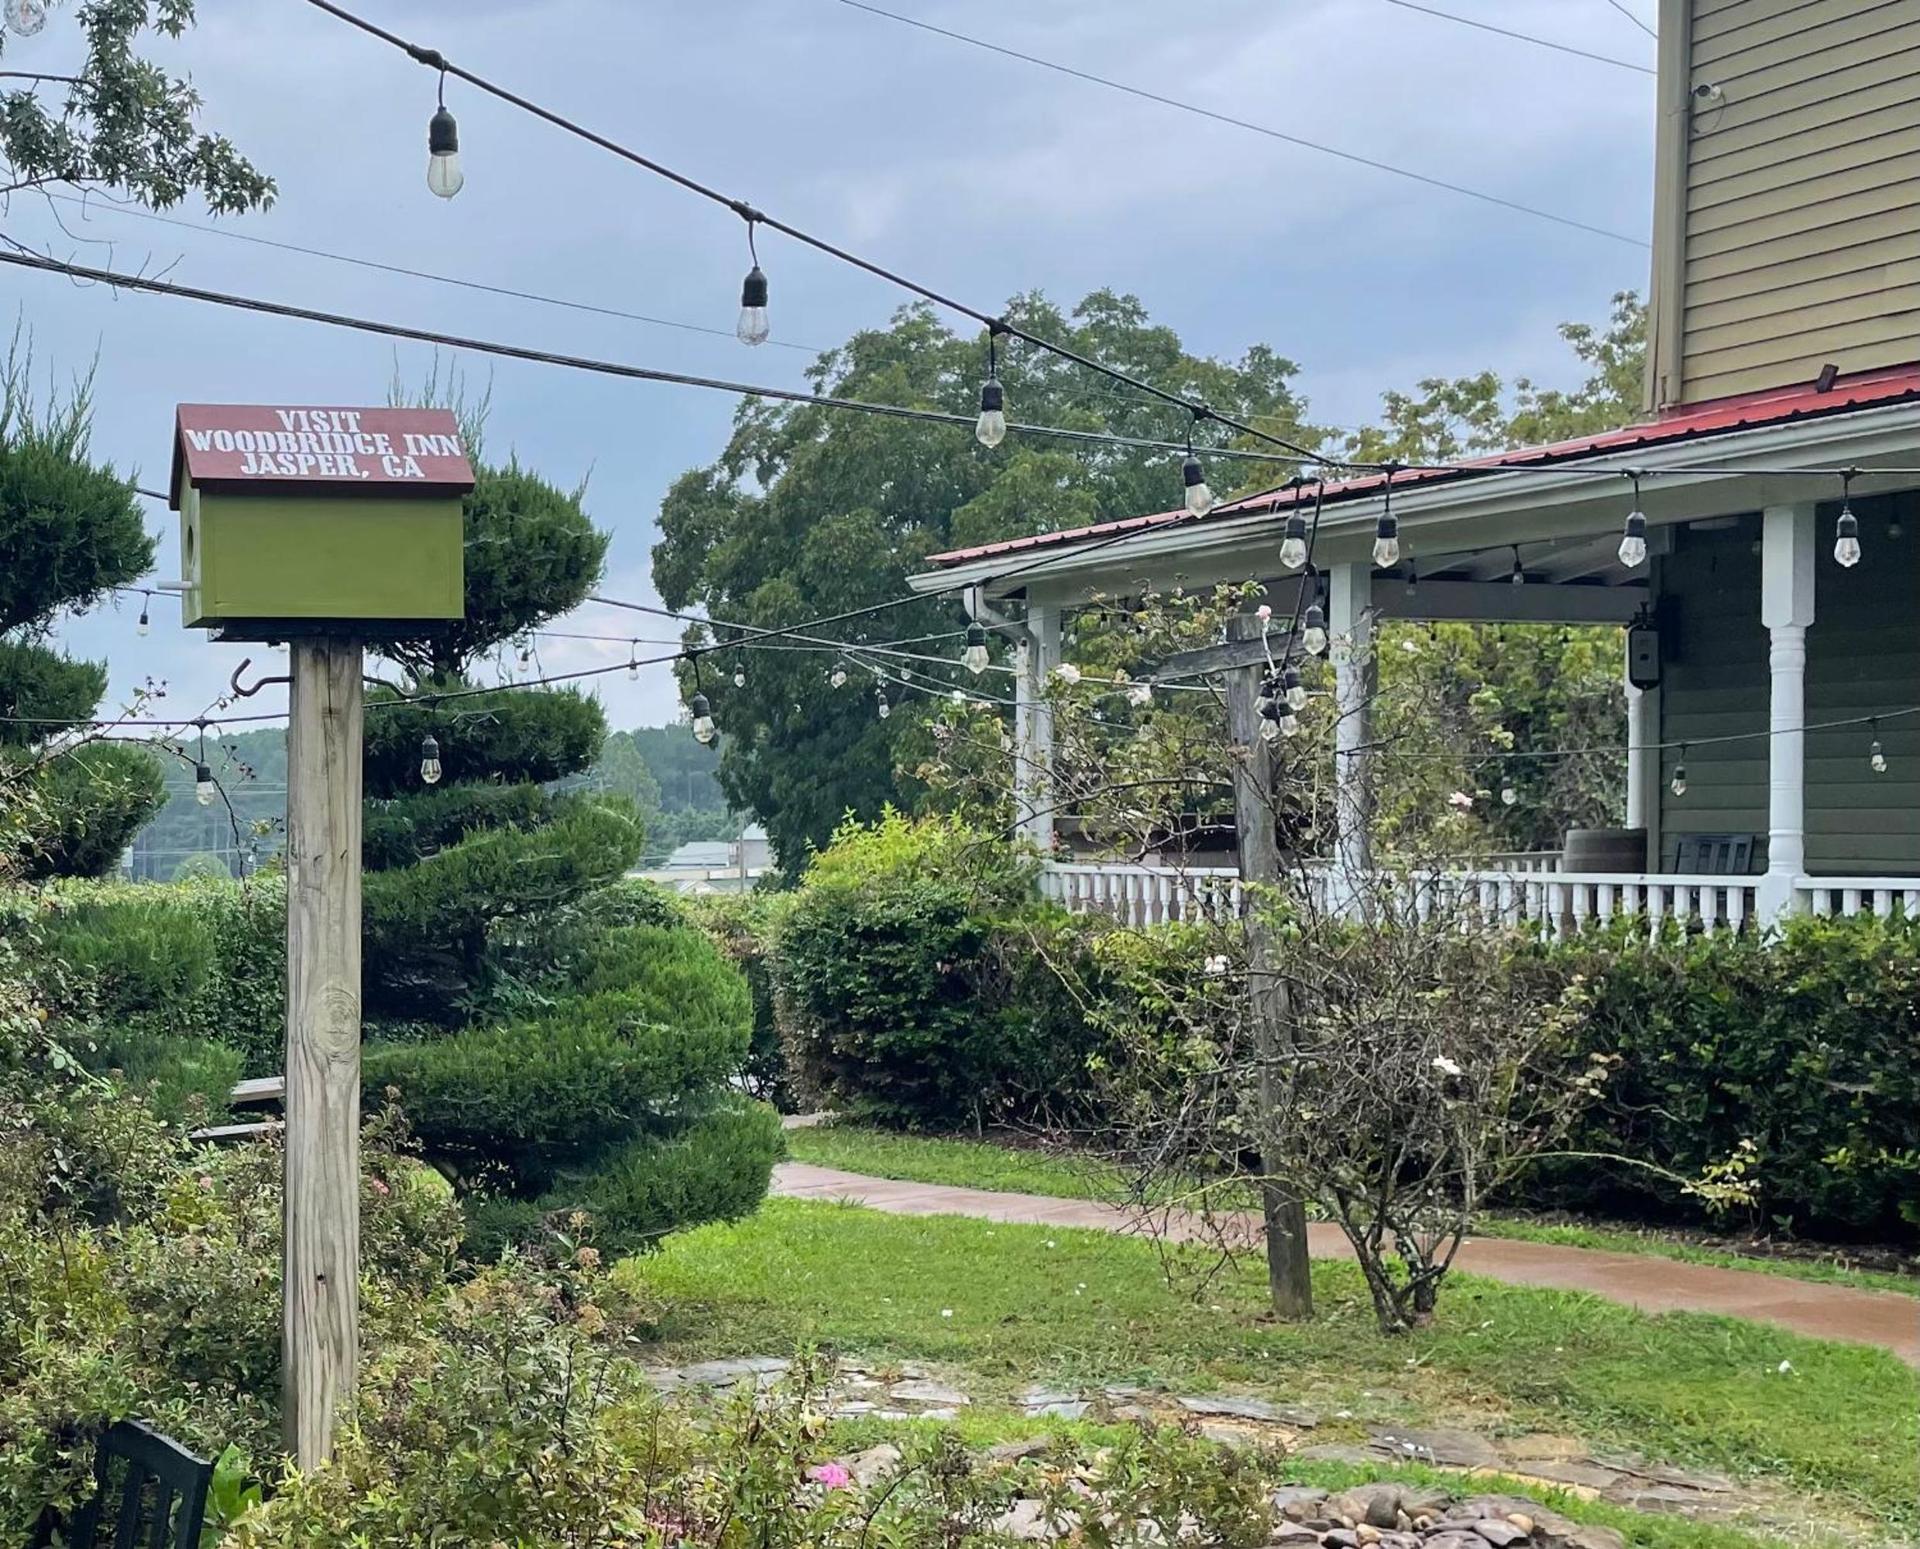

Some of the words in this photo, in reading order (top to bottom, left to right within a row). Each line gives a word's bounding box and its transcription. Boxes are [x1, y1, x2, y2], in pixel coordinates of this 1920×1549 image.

[276, 410, 360, 433] VISIT
[185, 429, 393, 455] WOODBRIDGE
[403, 434, 462, 457] INN
[240, 453, 369, 479] JASPER,
[383, 455, 425, 478] GA
